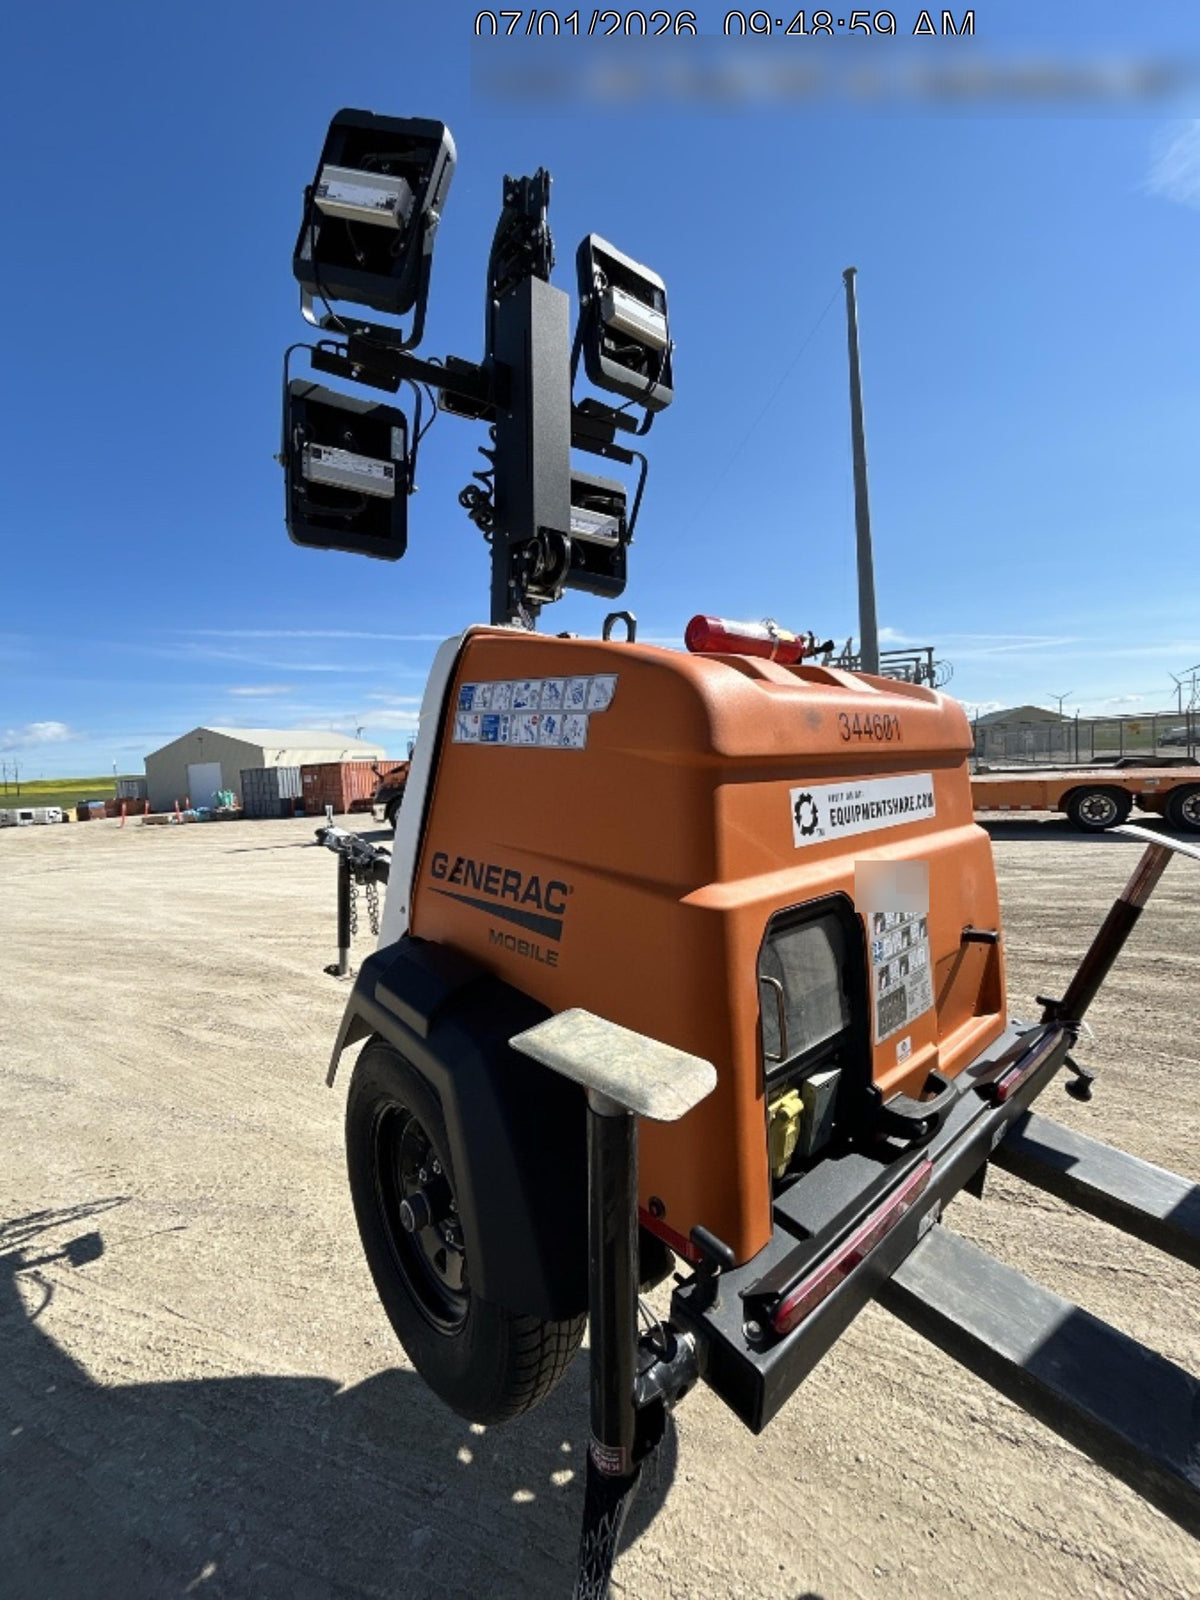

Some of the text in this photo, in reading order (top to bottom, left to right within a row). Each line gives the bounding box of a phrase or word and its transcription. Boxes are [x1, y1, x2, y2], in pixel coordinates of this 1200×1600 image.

[839, 713, 901, 741] 344601
[830, 793, 933, 827] EQUIPMENTSHARE.COM
[431, 852, 568, 915] GENERAC
[488, 929, 559, 967] MOBILE
